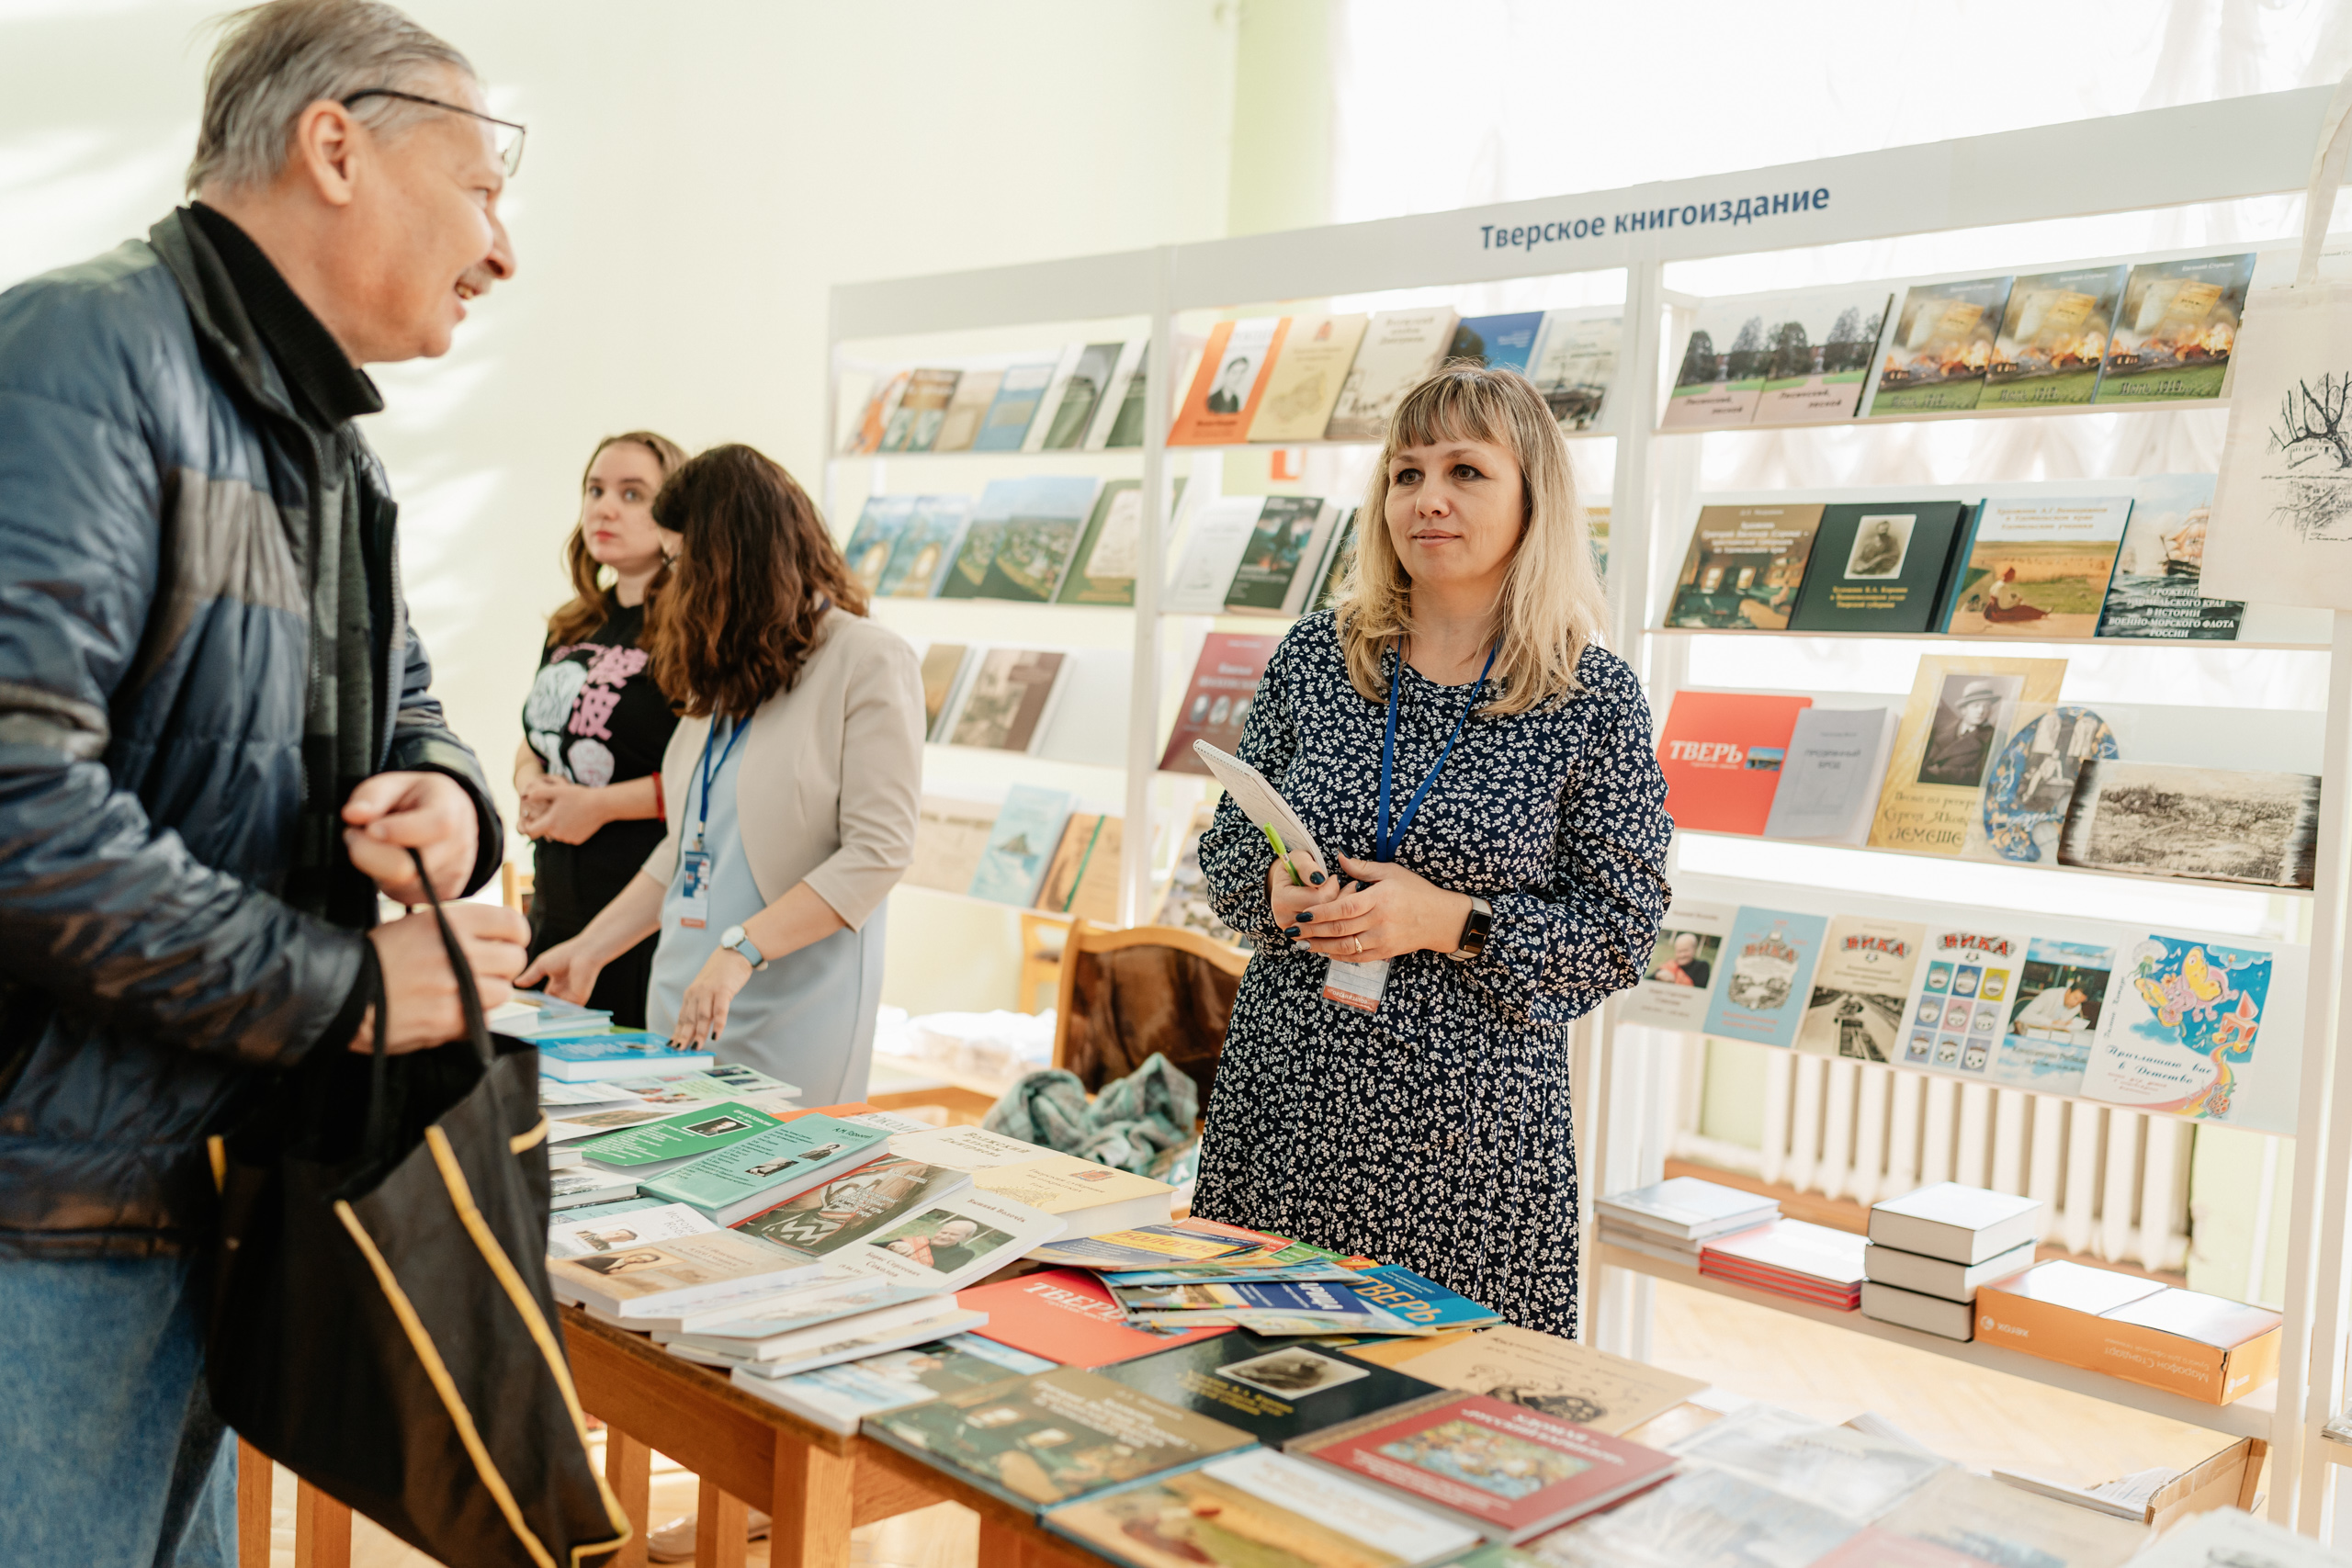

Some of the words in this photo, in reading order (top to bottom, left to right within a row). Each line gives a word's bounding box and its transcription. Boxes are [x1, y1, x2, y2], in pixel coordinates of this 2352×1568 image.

[1481, 217, 1605, 252] Тверское
[1614, 186, 1830, 235] книгоиздание
[2150, 629, 2189, 638] РОССИИ
[1668, 739, 1743, 764] ТВЕРЬ
[1889, 827, 1964, 847] ЛЕМЕШЕ
[1945, 934, 2008, 955] ВИКА
[963, 1132, 1032, 1154] Волжский
[967, 1198, 995, 1212] Вышний
[665, 1210, 700, 1235] Истори
[1112, 1230, 1222, 1255] Бологое
[1023, 1281, 1126, 1321] ТВЕРЬ
[1345, 1275, 1442, 1323] ТВЕРЬ
[1996, 1323, 2030, 1337] xerox
[2104, 1347, 2154, 1369] Стандарт
[2156, 1360, 2210, 1383] Марафон
